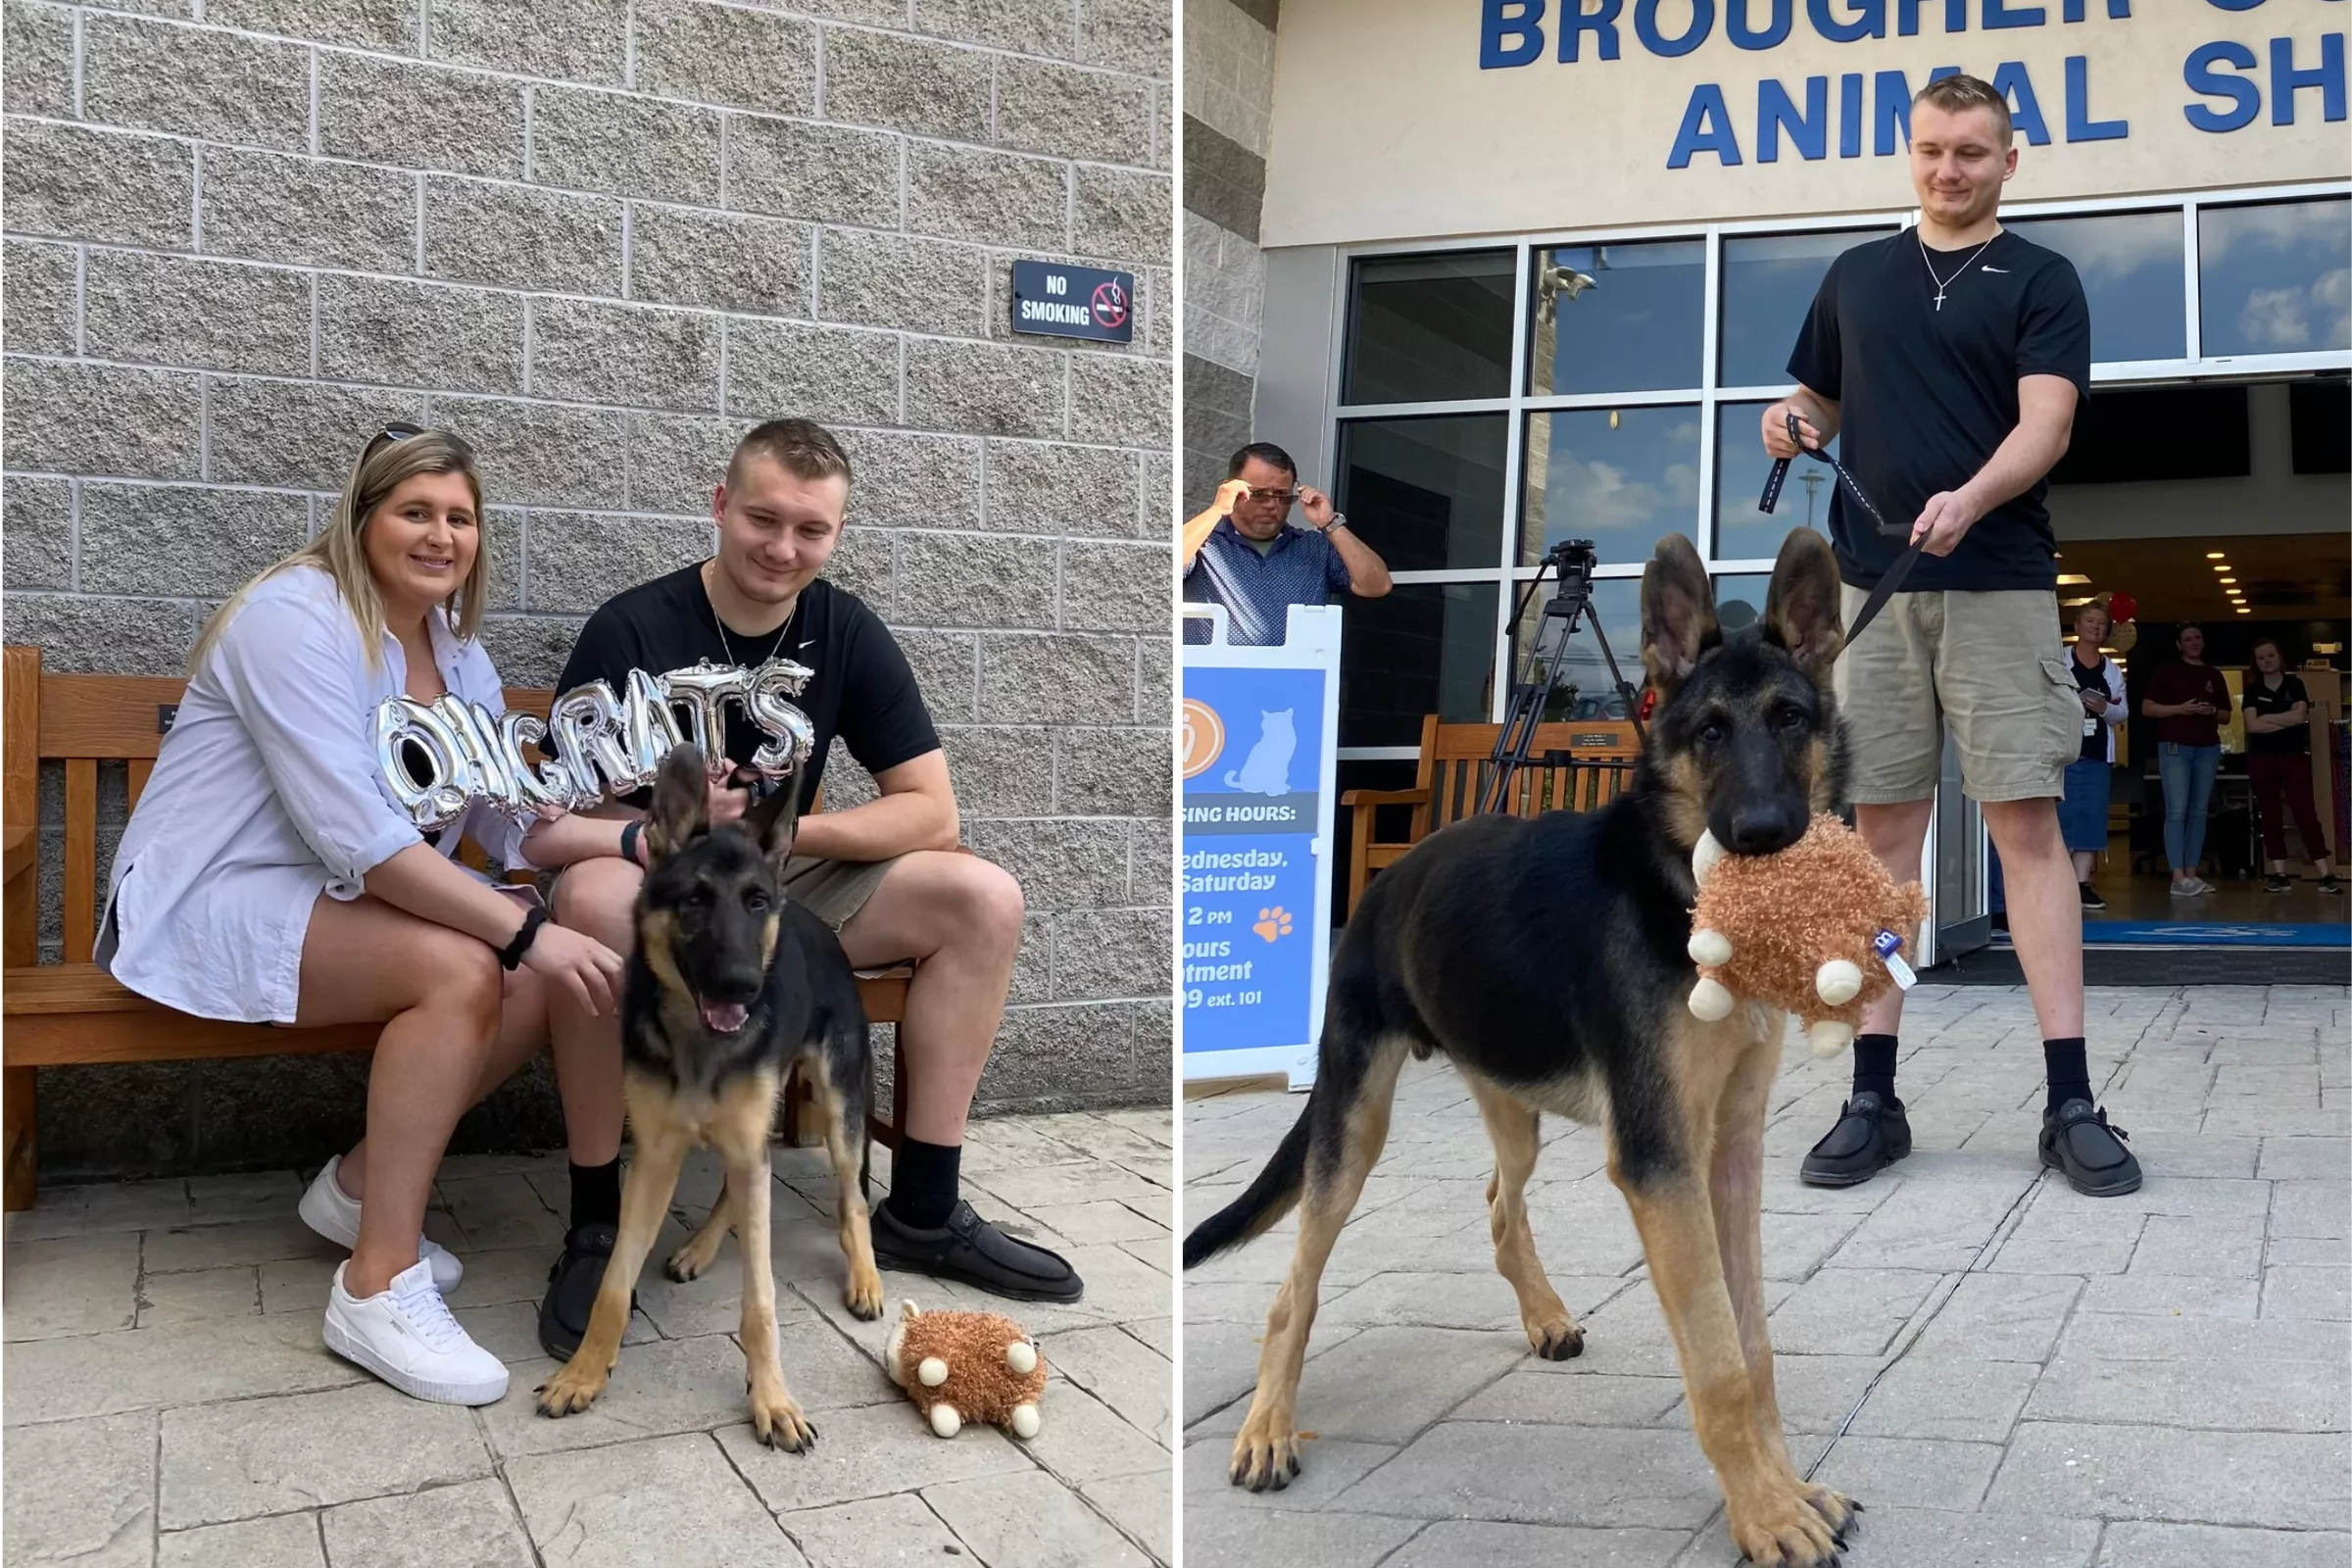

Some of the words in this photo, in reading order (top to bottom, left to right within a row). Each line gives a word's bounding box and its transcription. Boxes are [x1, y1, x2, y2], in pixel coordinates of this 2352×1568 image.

[1479, 0, 2132, 70] BROUG
[1666, 55, 2129, 170] ANIMAL
[2183, 32, 2348, 134] SH
[1046, 274, 1067, 296] NO
[1021, 299, 1090, 326] SMOKING
[1225, 805, 1297, 822] HOURS:
[1188, 906, 1203, 926] 2
[1206, 992, 1236, 1007] ext.
[1239, 989, 1262, 1005] 101
